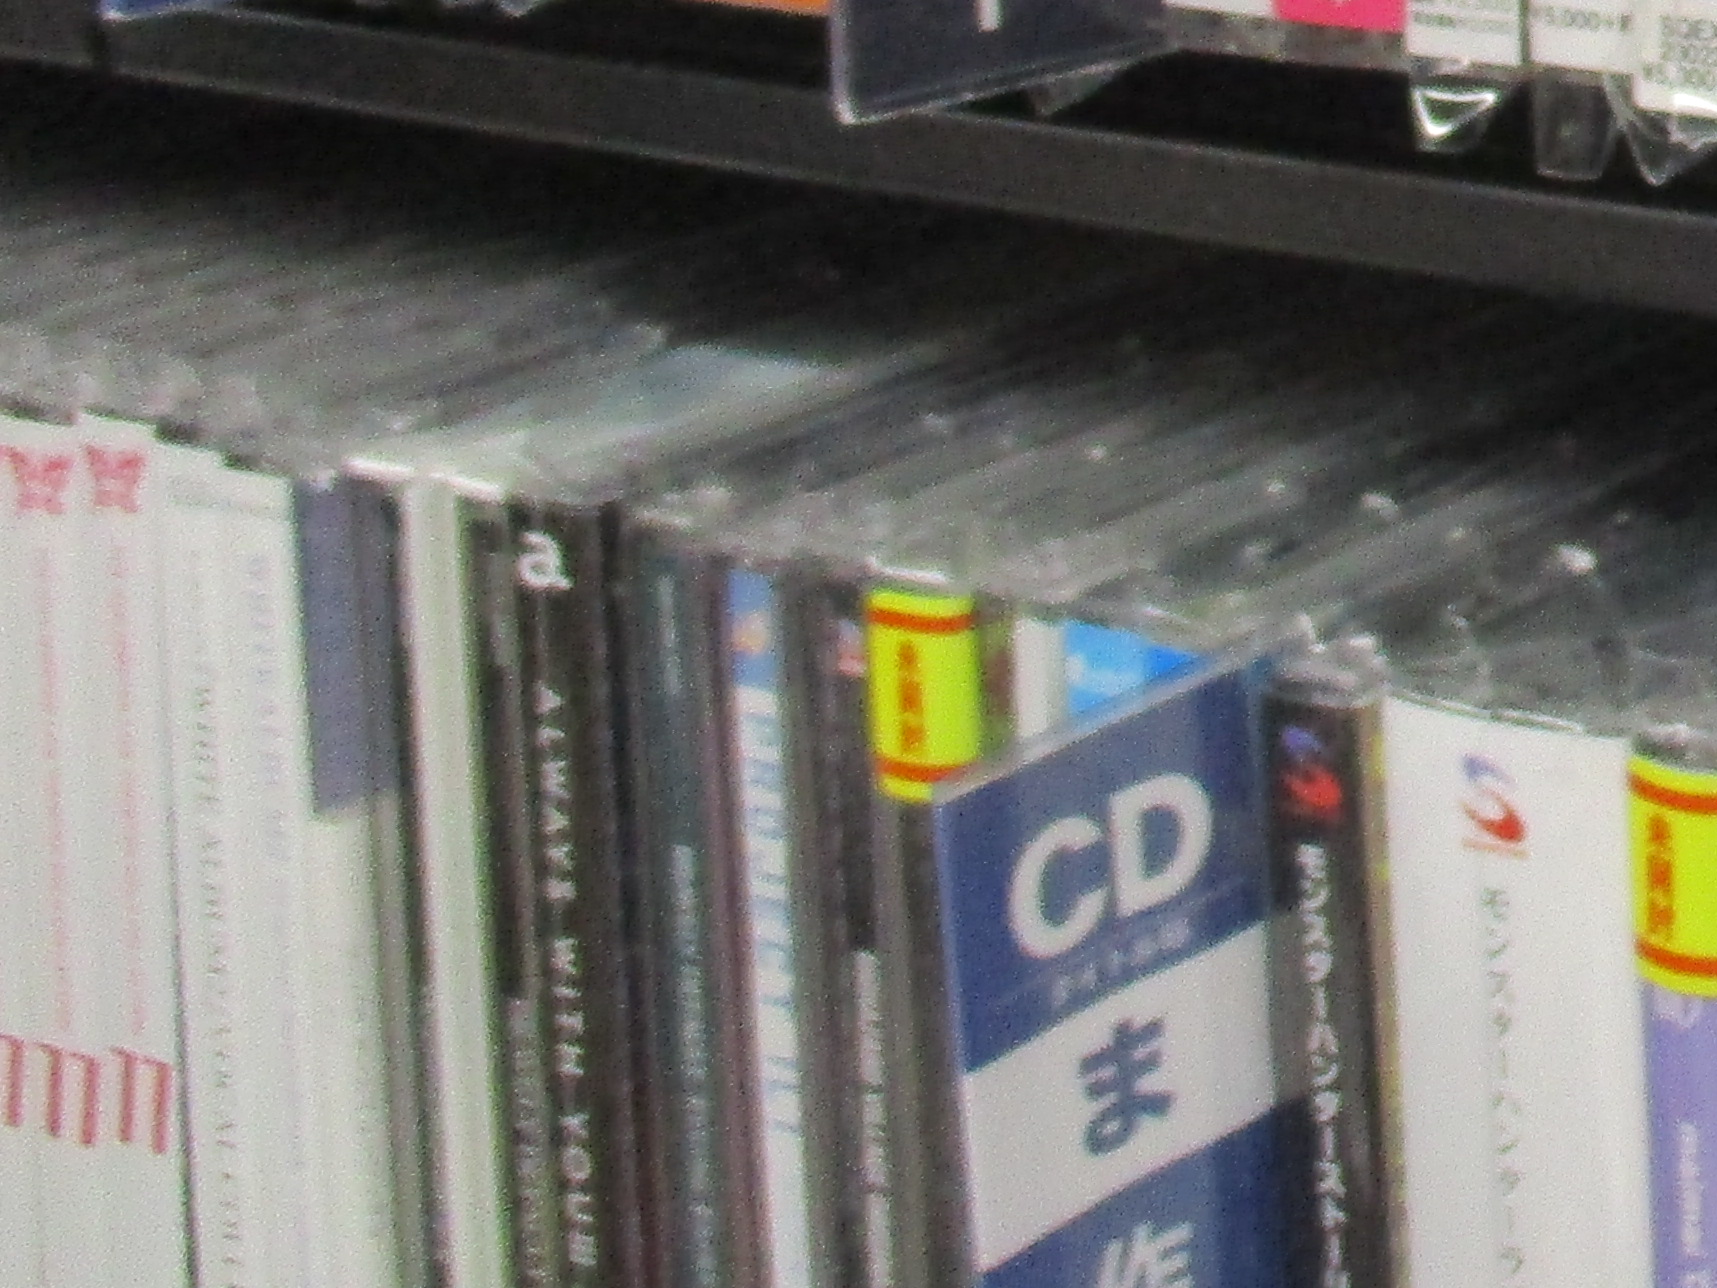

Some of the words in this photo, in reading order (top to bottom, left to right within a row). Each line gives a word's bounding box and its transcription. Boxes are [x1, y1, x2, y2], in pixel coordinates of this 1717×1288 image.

[1009, 770, 1215, 960] CD
[552, 936, 587, 1078] WITH
[1076, 1011, 1174, 1158] ま
